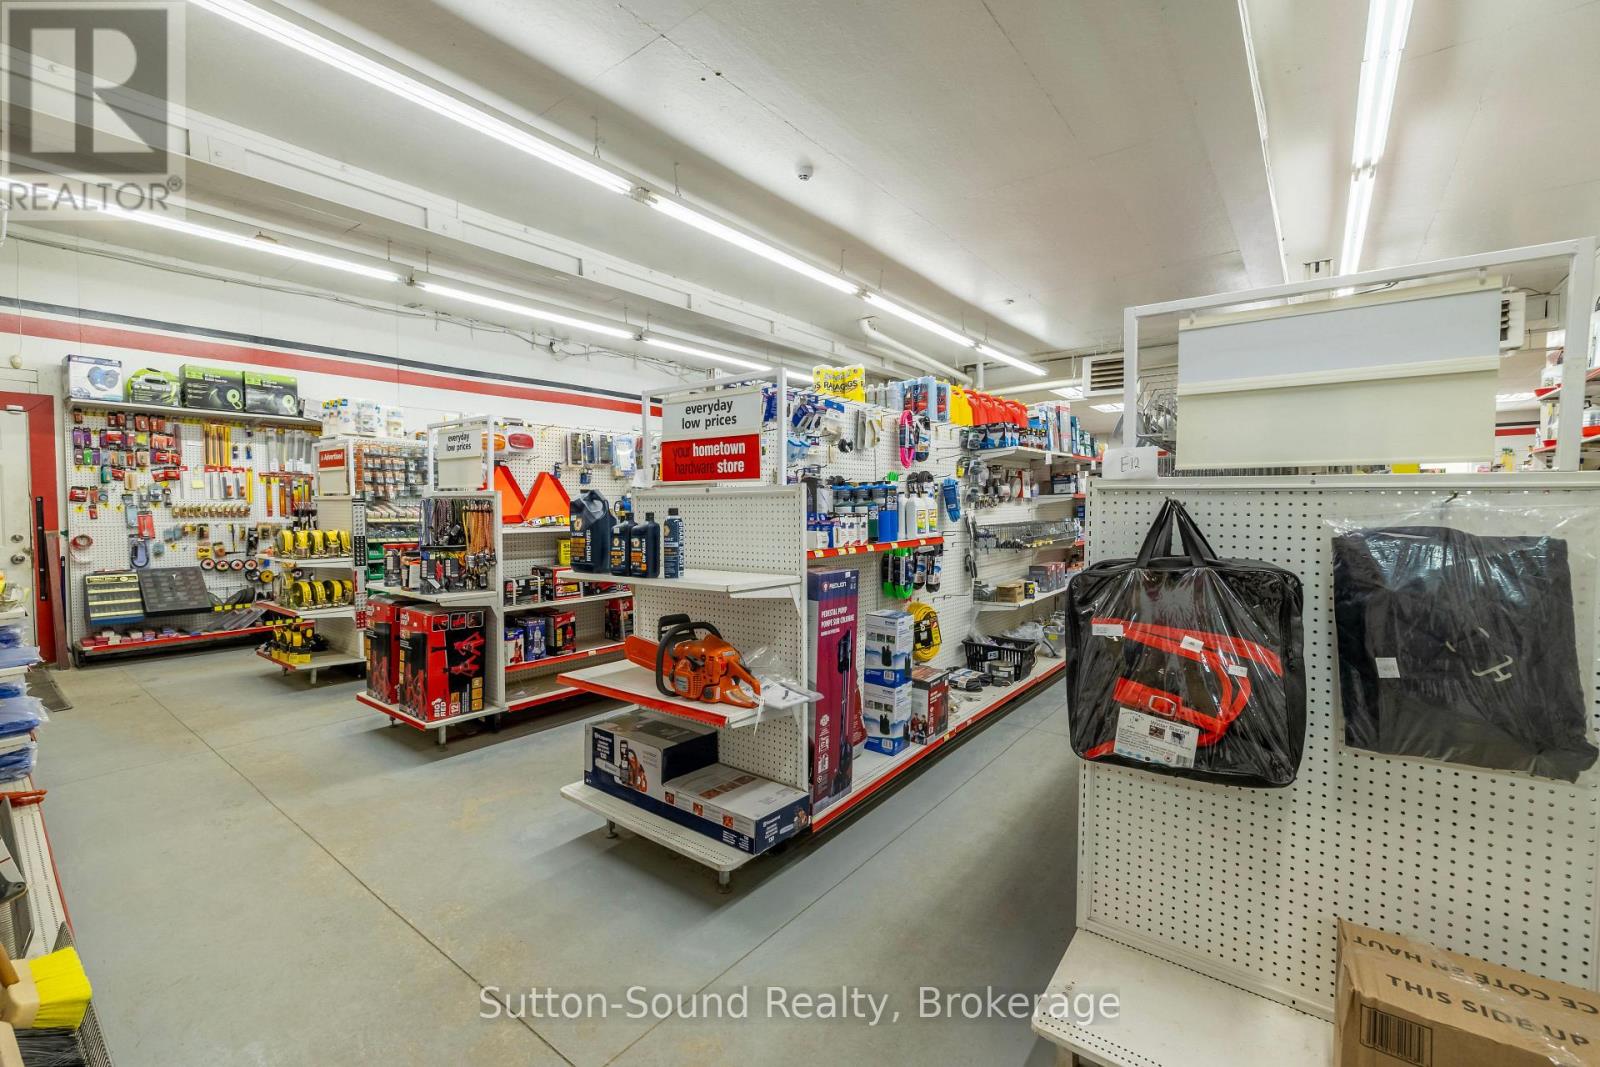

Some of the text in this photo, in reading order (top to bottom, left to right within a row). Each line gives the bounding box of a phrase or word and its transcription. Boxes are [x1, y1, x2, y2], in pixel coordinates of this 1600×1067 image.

[685, 398, 734, 415] everyday
[682, 414, 737, 430] low prices
[447, 433, 470, 443] everyday
[446, 443, 472, 452] low prices
[672, 441, 746, 459] your hometown
[674, 459, 745, 476] hardware store
[1353, 936, 1422, 964] HAUT
[1385, 973, 1591, 1047] THIS SIDE UP
[1558, 996, 1599, 1015] CE
